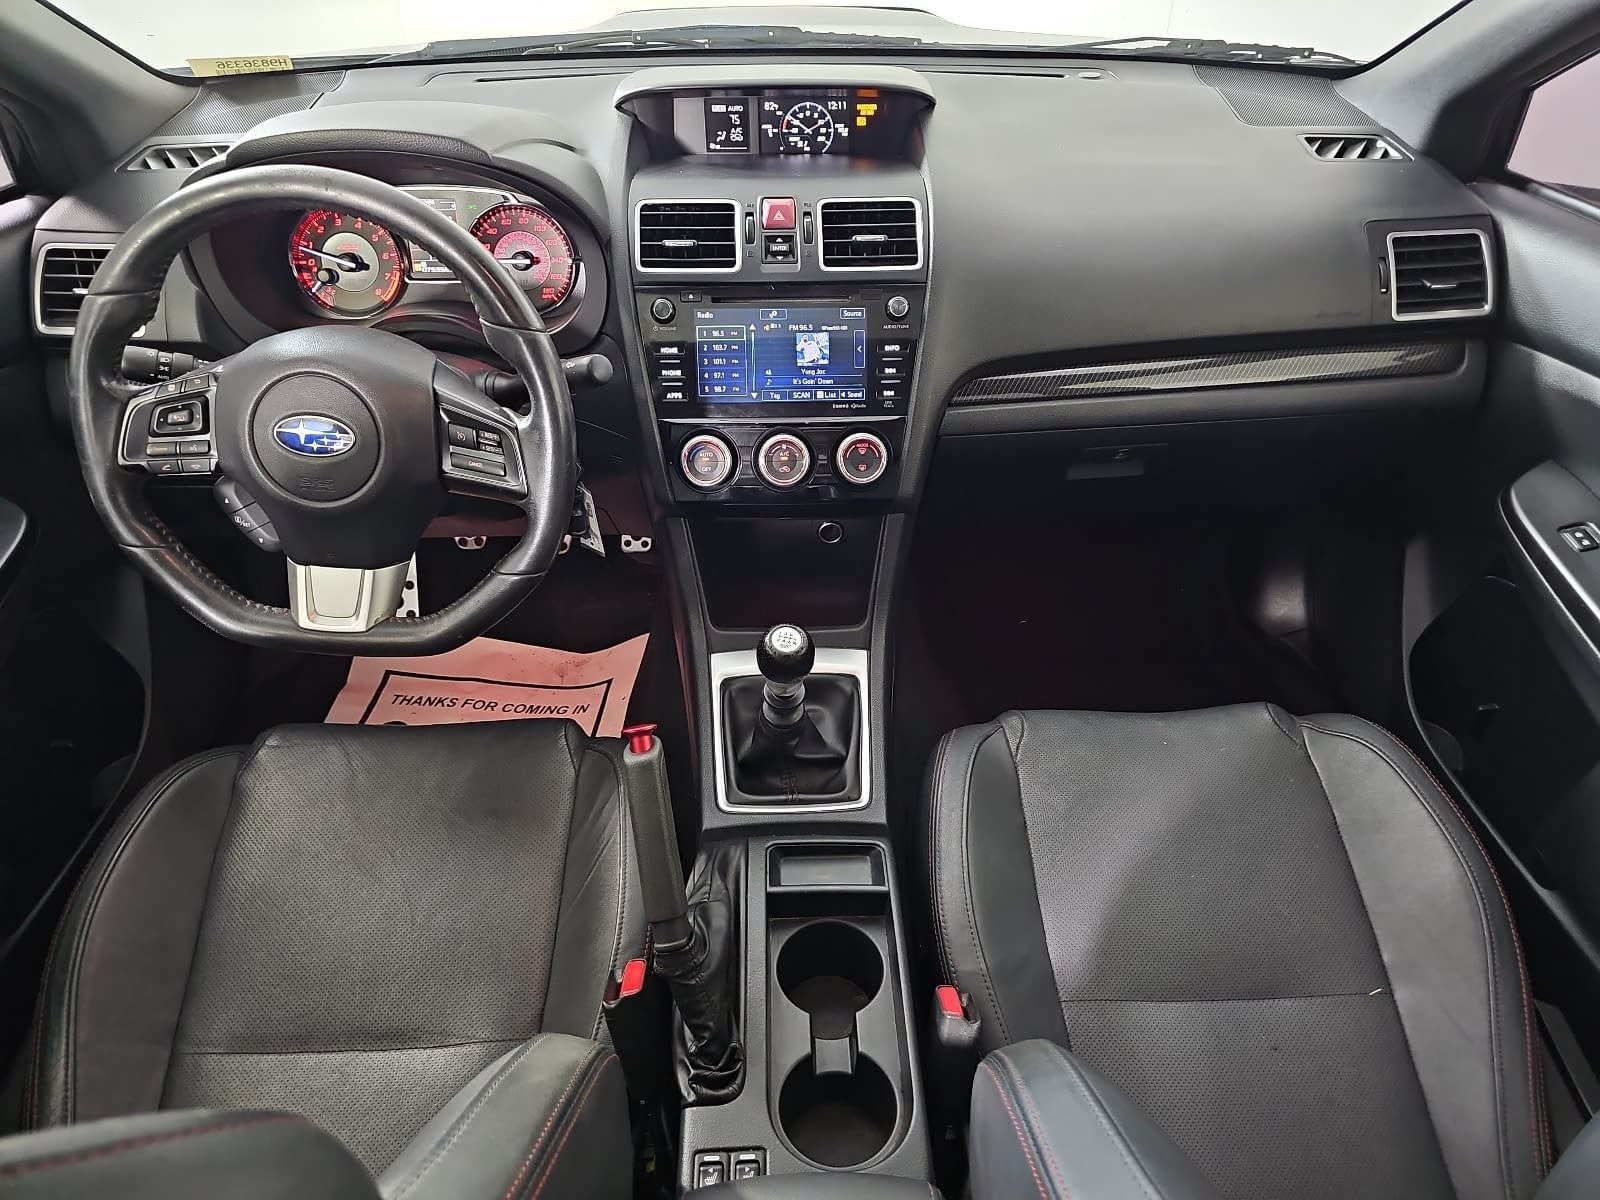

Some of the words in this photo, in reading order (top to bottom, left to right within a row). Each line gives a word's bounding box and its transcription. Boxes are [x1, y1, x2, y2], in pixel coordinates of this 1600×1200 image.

[828, 101, 847, 110] 12:11
[729, 114, 741, 125] 75
[316, 225, 326, 234] 2
[371, 234, 379, 242] 5
[697, 311, 714, 319] Radio
[884, 344, 901, 352] INFO
[704, 385, 709, 393] 5
[792, 391, 811, 399] SCAN
[391, 694, 459, 708] THANKS
[460, 698, 499, 712] FOR
[501, 703, 570, 715] COMING
[571, 703, 591, 715] IN
